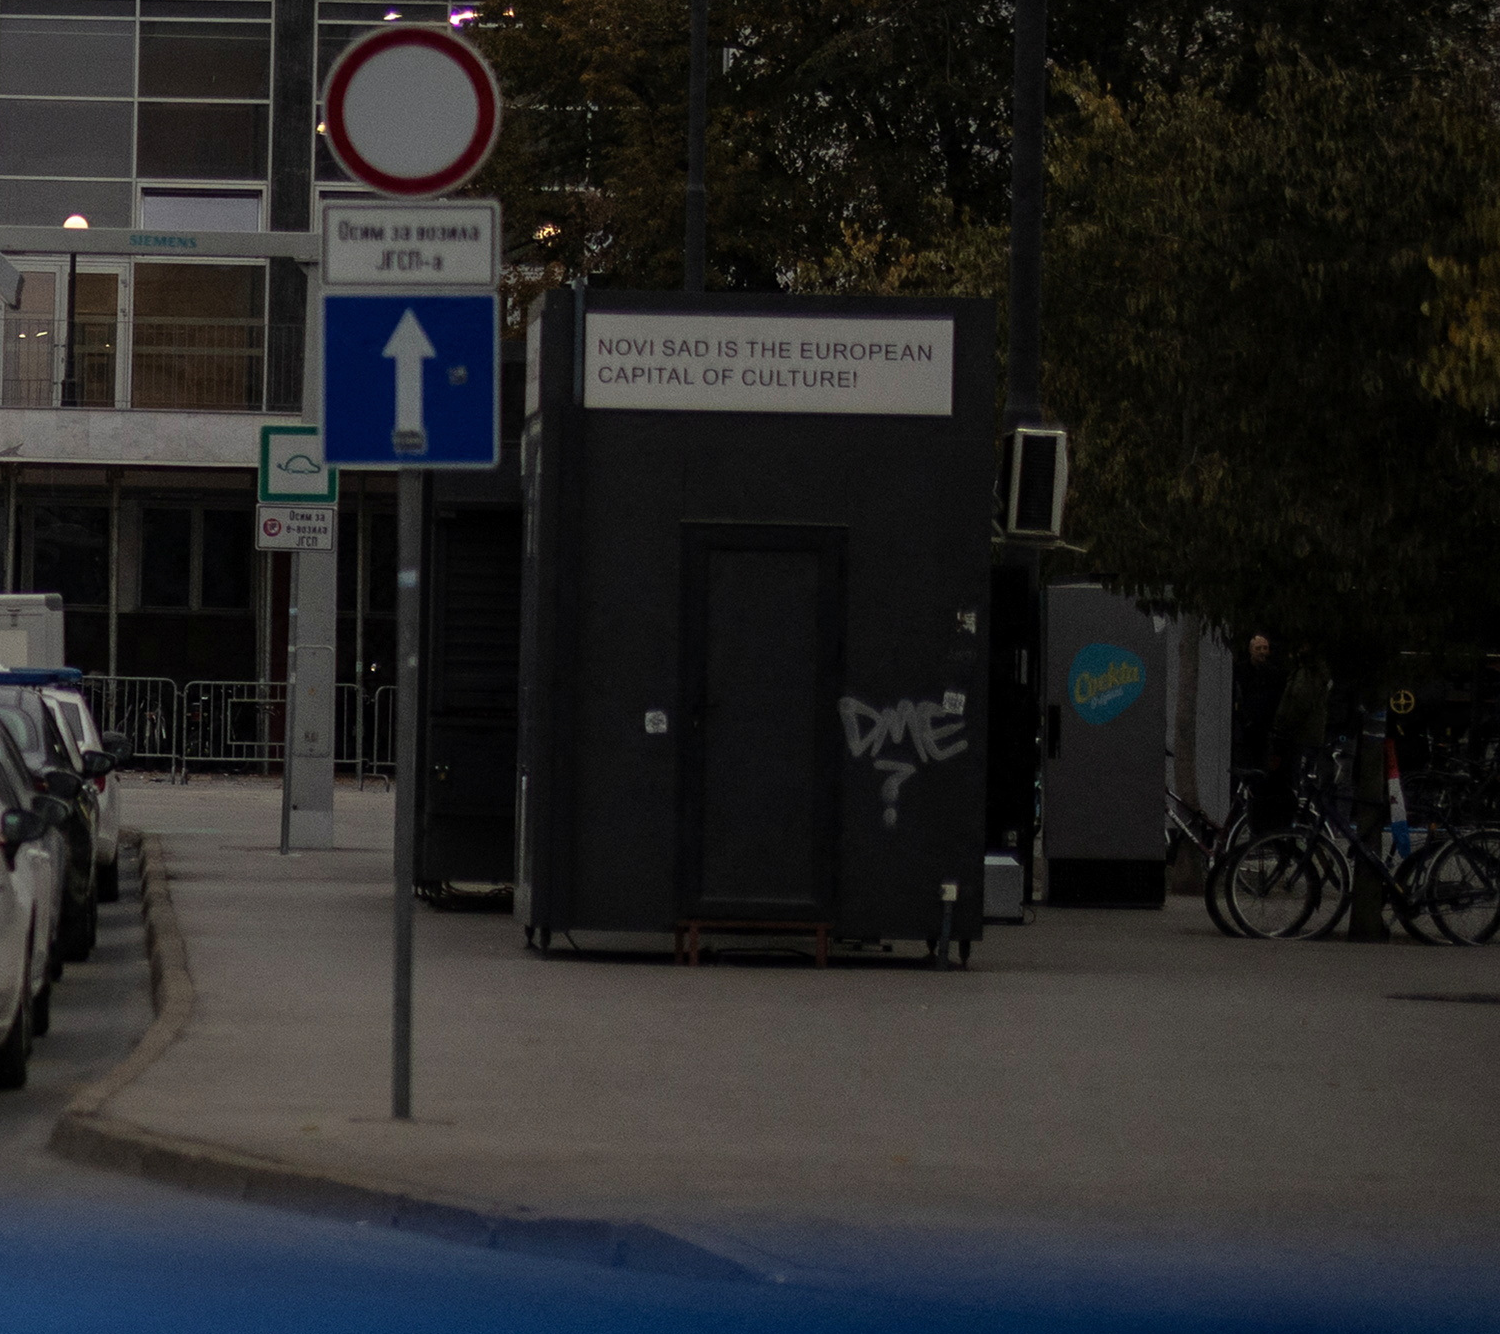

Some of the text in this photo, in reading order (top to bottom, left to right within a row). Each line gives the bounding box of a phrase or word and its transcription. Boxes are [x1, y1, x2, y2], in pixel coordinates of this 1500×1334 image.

[598, 339, 933, 362] NOVI SAD IS THE EUROPEAN
[598, 367, 858, 389] CAPITAL OF CULTURE!
[289, 510, 312, 521] Осим
[296, 536, 318, 547] ЈГСП
